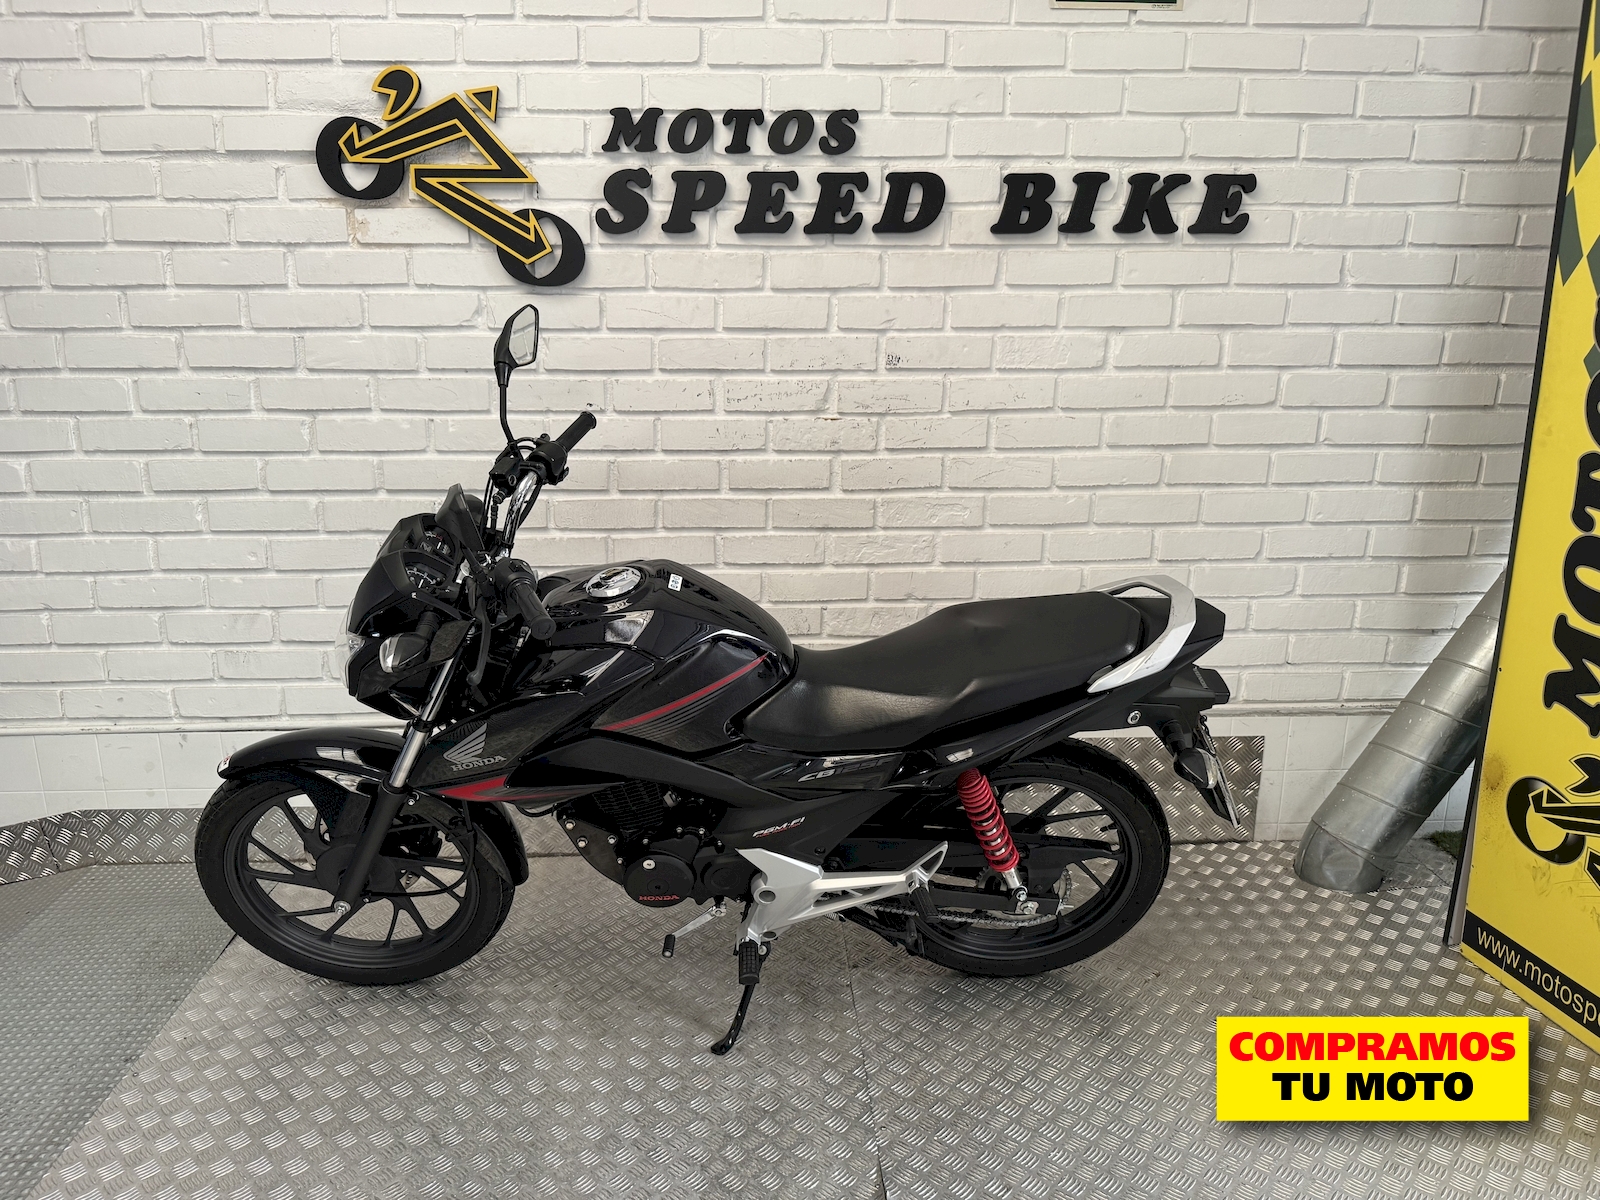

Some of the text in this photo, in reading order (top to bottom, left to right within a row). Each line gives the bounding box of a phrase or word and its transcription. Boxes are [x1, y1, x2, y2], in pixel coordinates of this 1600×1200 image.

[602, 107, 859, 155] MOTOS
[595, 167, 1257, 235] SPEED BIKE
[450, 755, 507, 771] HONDA
[1477, 926, 1600, 1027] www.motosp
